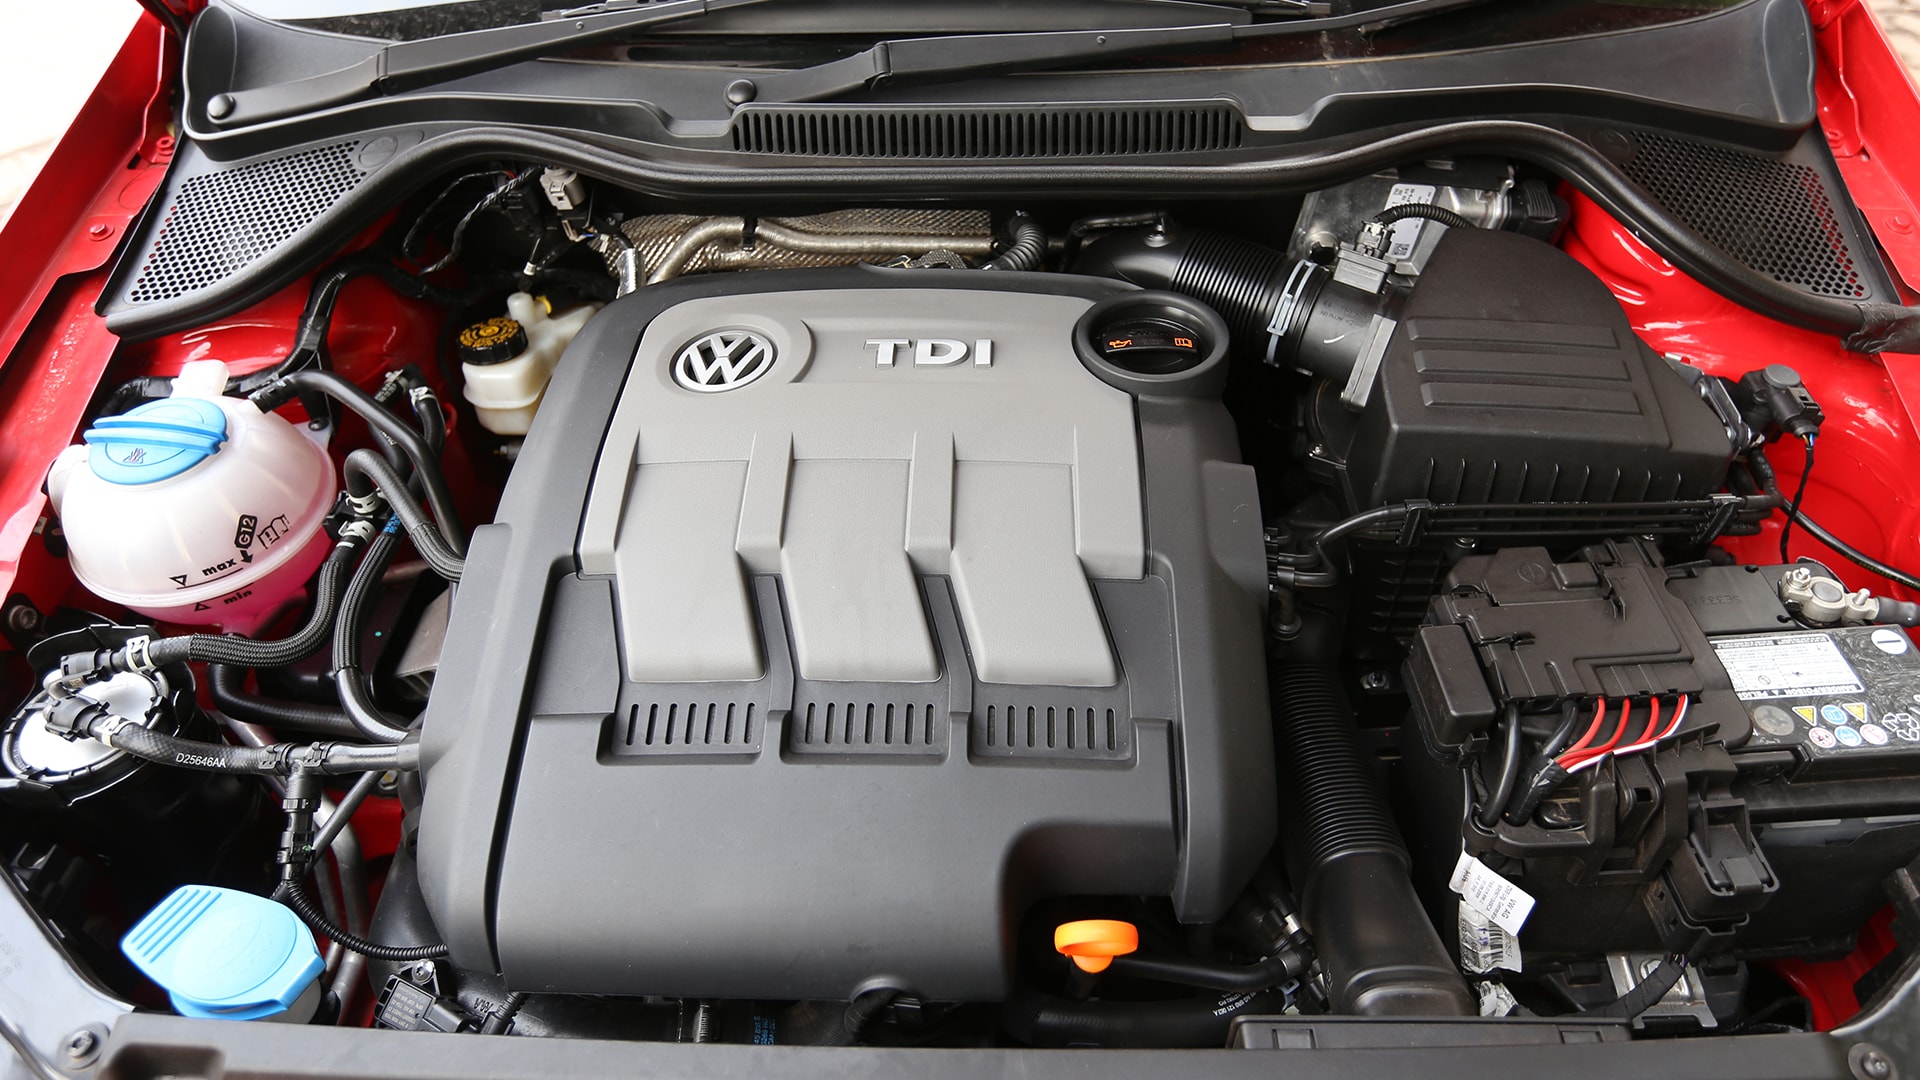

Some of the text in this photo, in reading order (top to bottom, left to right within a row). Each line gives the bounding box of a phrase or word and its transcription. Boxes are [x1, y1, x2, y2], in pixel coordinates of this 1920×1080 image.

[674, 330, 775, 392] VW
[864, 338, 994, 369] TDI
[238, 517, 255, 546] G12
[202, 558, 237, 576] max
[223, 590, 253, 604] min
[175, 752, 227, 768] D25646AA
